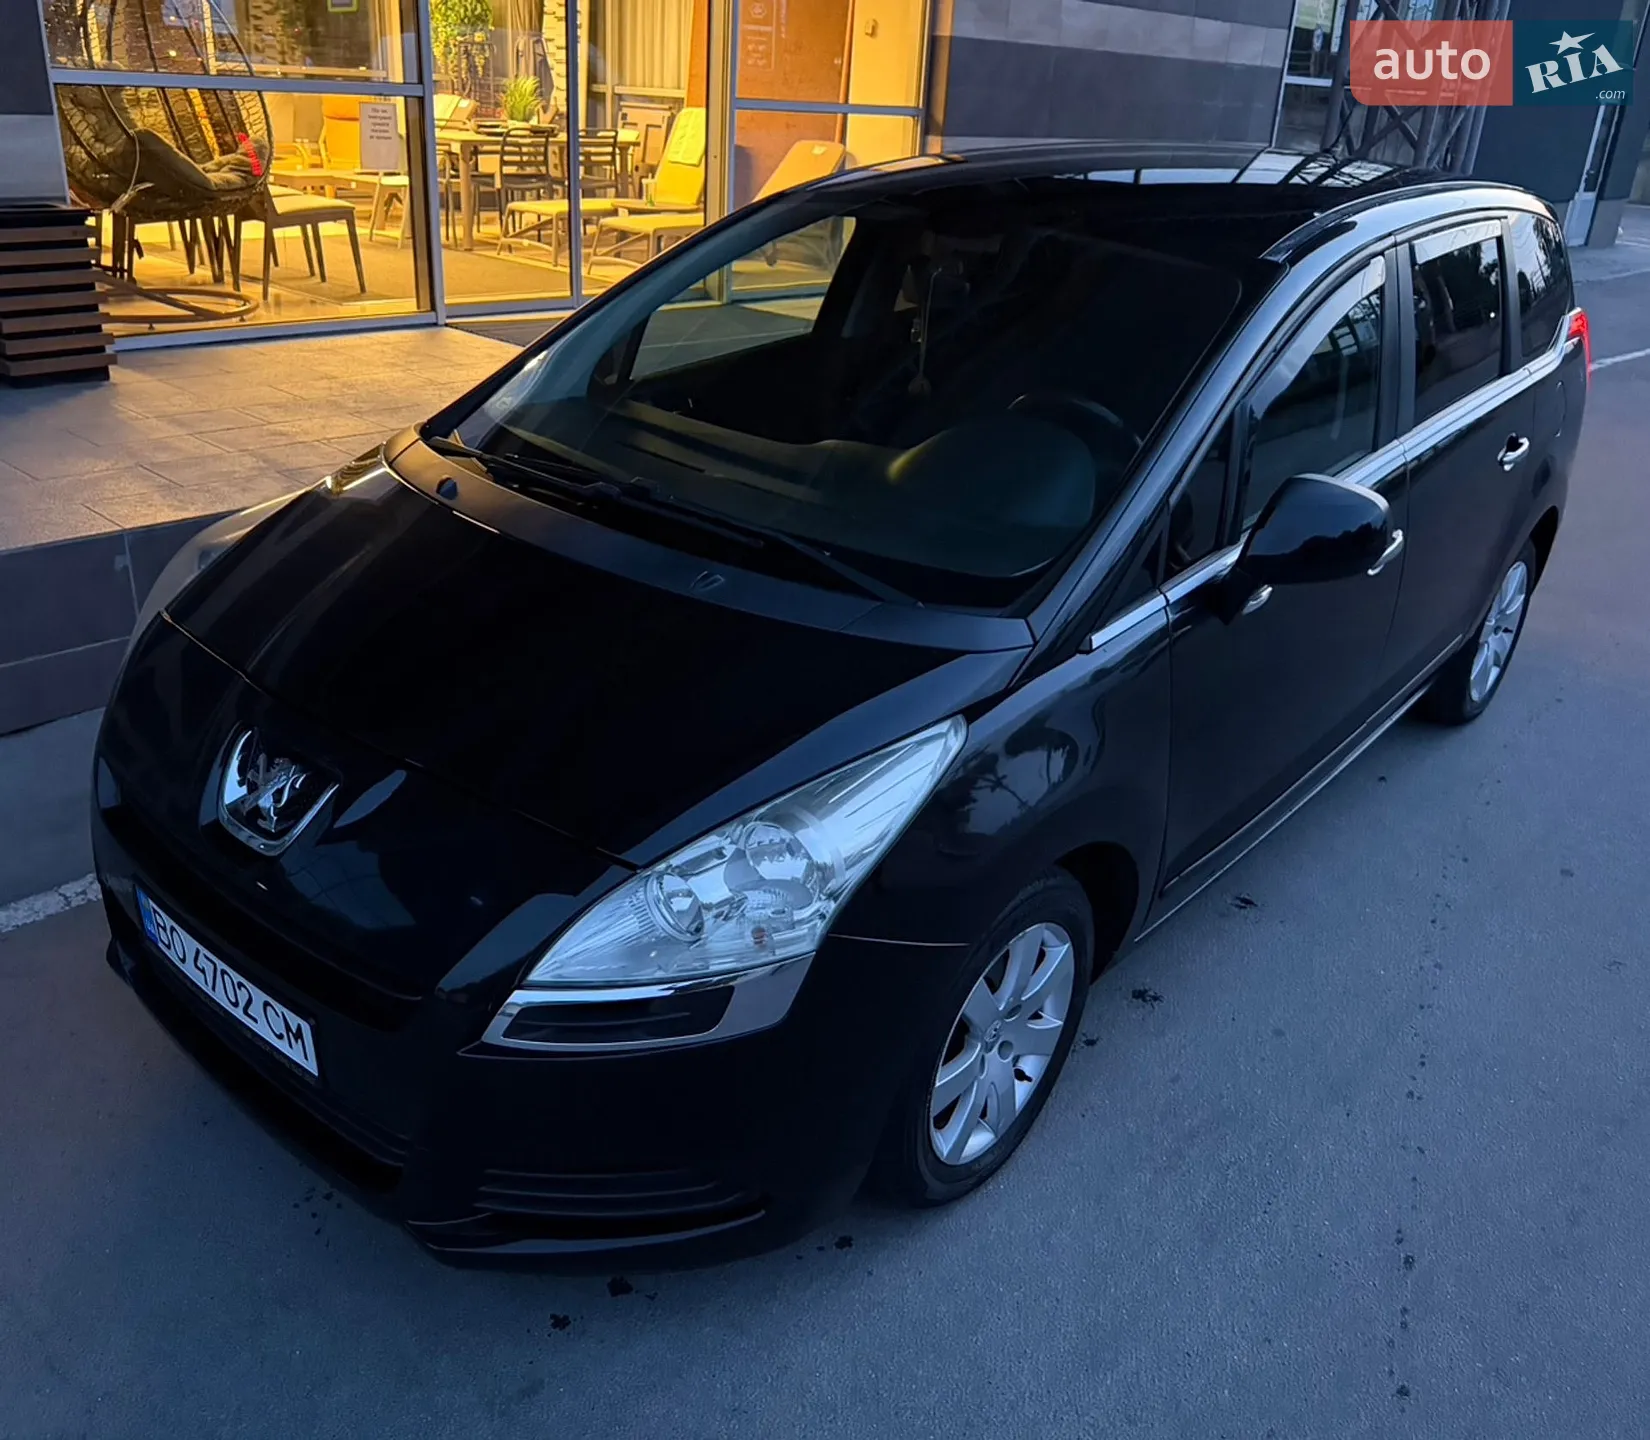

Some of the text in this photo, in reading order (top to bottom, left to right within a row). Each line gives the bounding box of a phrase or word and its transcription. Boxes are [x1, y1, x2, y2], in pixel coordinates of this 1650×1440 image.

[152, 907, 309, 1062] BO 4702 CM
